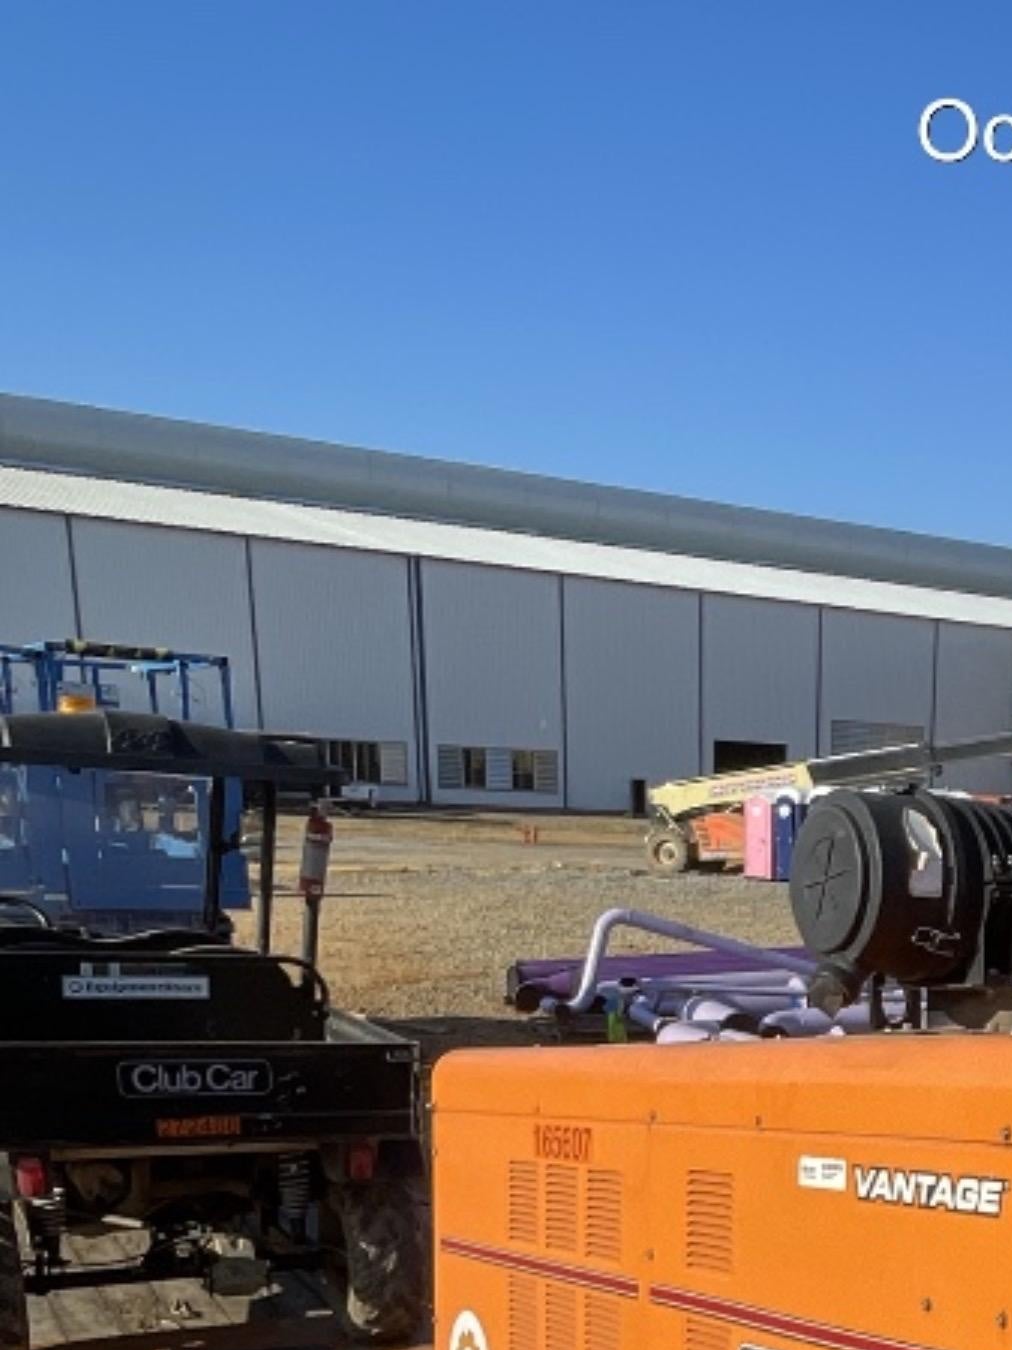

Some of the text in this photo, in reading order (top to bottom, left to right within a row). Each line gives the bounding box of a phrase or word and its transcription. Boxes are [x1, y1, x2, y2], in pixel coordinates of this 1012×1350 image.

[131, 1063, 259, 1093] Club Car
[852, 1164, 1005, 1217] VANTAGE
